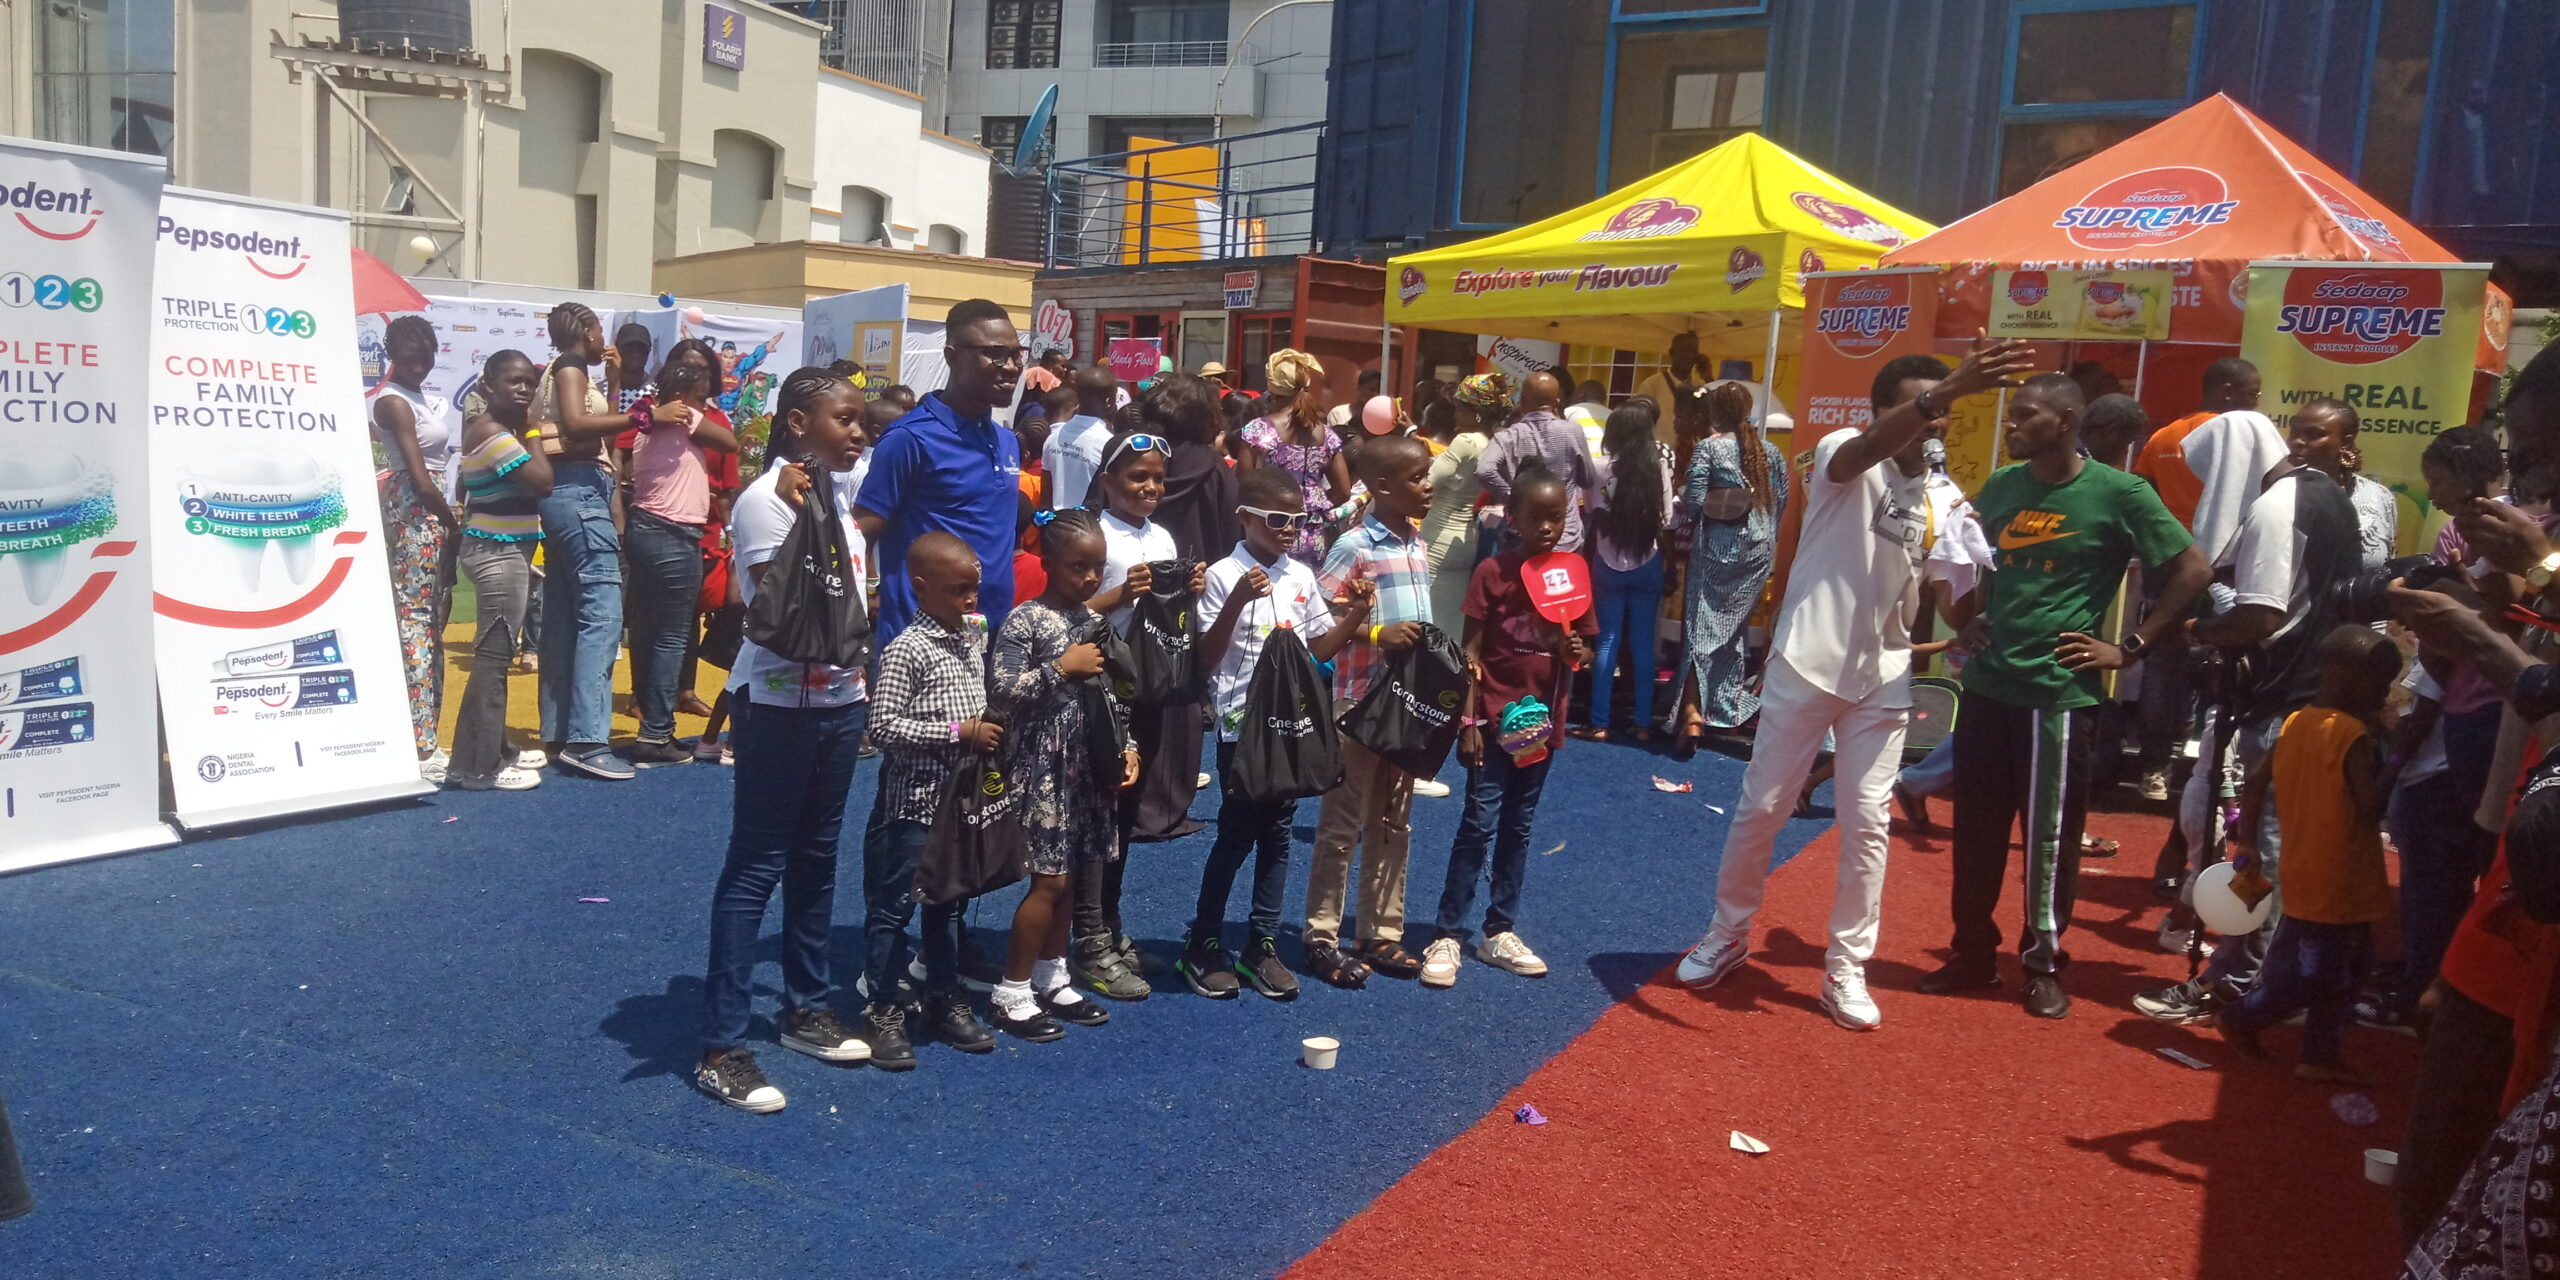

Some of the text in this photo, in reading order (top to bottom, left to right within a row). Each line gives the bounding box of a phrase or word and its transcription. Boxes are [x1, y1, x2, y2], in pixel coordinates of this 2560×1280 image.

[712, 40, 742, 57] POLARIS
[716, 50, 737, 64] BANK
[2123, 193, 2187, 204] Sedaap
[2053, 200, 2240, 232] SUPREME
[156, 216, 300, 258] Pepsodent
[1453, 263, 1679, 297] Explore your Flavour
[1225, 289, 1254, 307] TREAT
[1838, 285, 1891, 303] Sedaap
[2312, 281, 2408, 302] Sedaap
[162, 297, 238, 320] TRIPLE
[2026, 310, 2053, 320] REAL
[164, 318, 239, 332] PROTECTION
[1817, 306, 1911, 338] SUPREME
[2276, 305, 2446, 342] SUPREME
[2313, 343, 2399, 353] INSTANT NOODLES
[1109, 350, 1133, 368] Candy
[165, 356, 318, 384] COMPLETE
[197, 382, 295, 405] FAMILY
[2281, 383, 2429, 410] WITH REAL
[154, 405, 336, 432] PROTECTION
[1808, 407, 1845, 425] RICH
[212, 491, 293, 503] ANTI-CAVITY
[190, 501, 299, 521] 2 WHITE TEETH
[192, 520, 311, 537] 3 FRESH BREATH
[2009, 510, 2067, 535] NIKE
[232, 651, 284, 667] Pepsodent
[23, 682, 55, 692] COMPLETE
[301, 676, 327, 684] TRIPLE
[216, 683, 286, 702] Pepsodent
[26, 711, 59, 721] TRIPLE
[255, 706, 333, 721] Every Smile Matters
[25, 729, 60, 738] COMPLETE
[25, 746, 62, 758] Matters
[227, 752, 255, 761] NIGERIA
[228, 760, 255, 769] DENTAL
[229, 766, 275, 777] ASSOCIATION
[56, 786, 94, 797] PEPSODENT
[95, 782, 121, 791] NIGERIA
[56, 794, 92, 804] FACEBOOK
